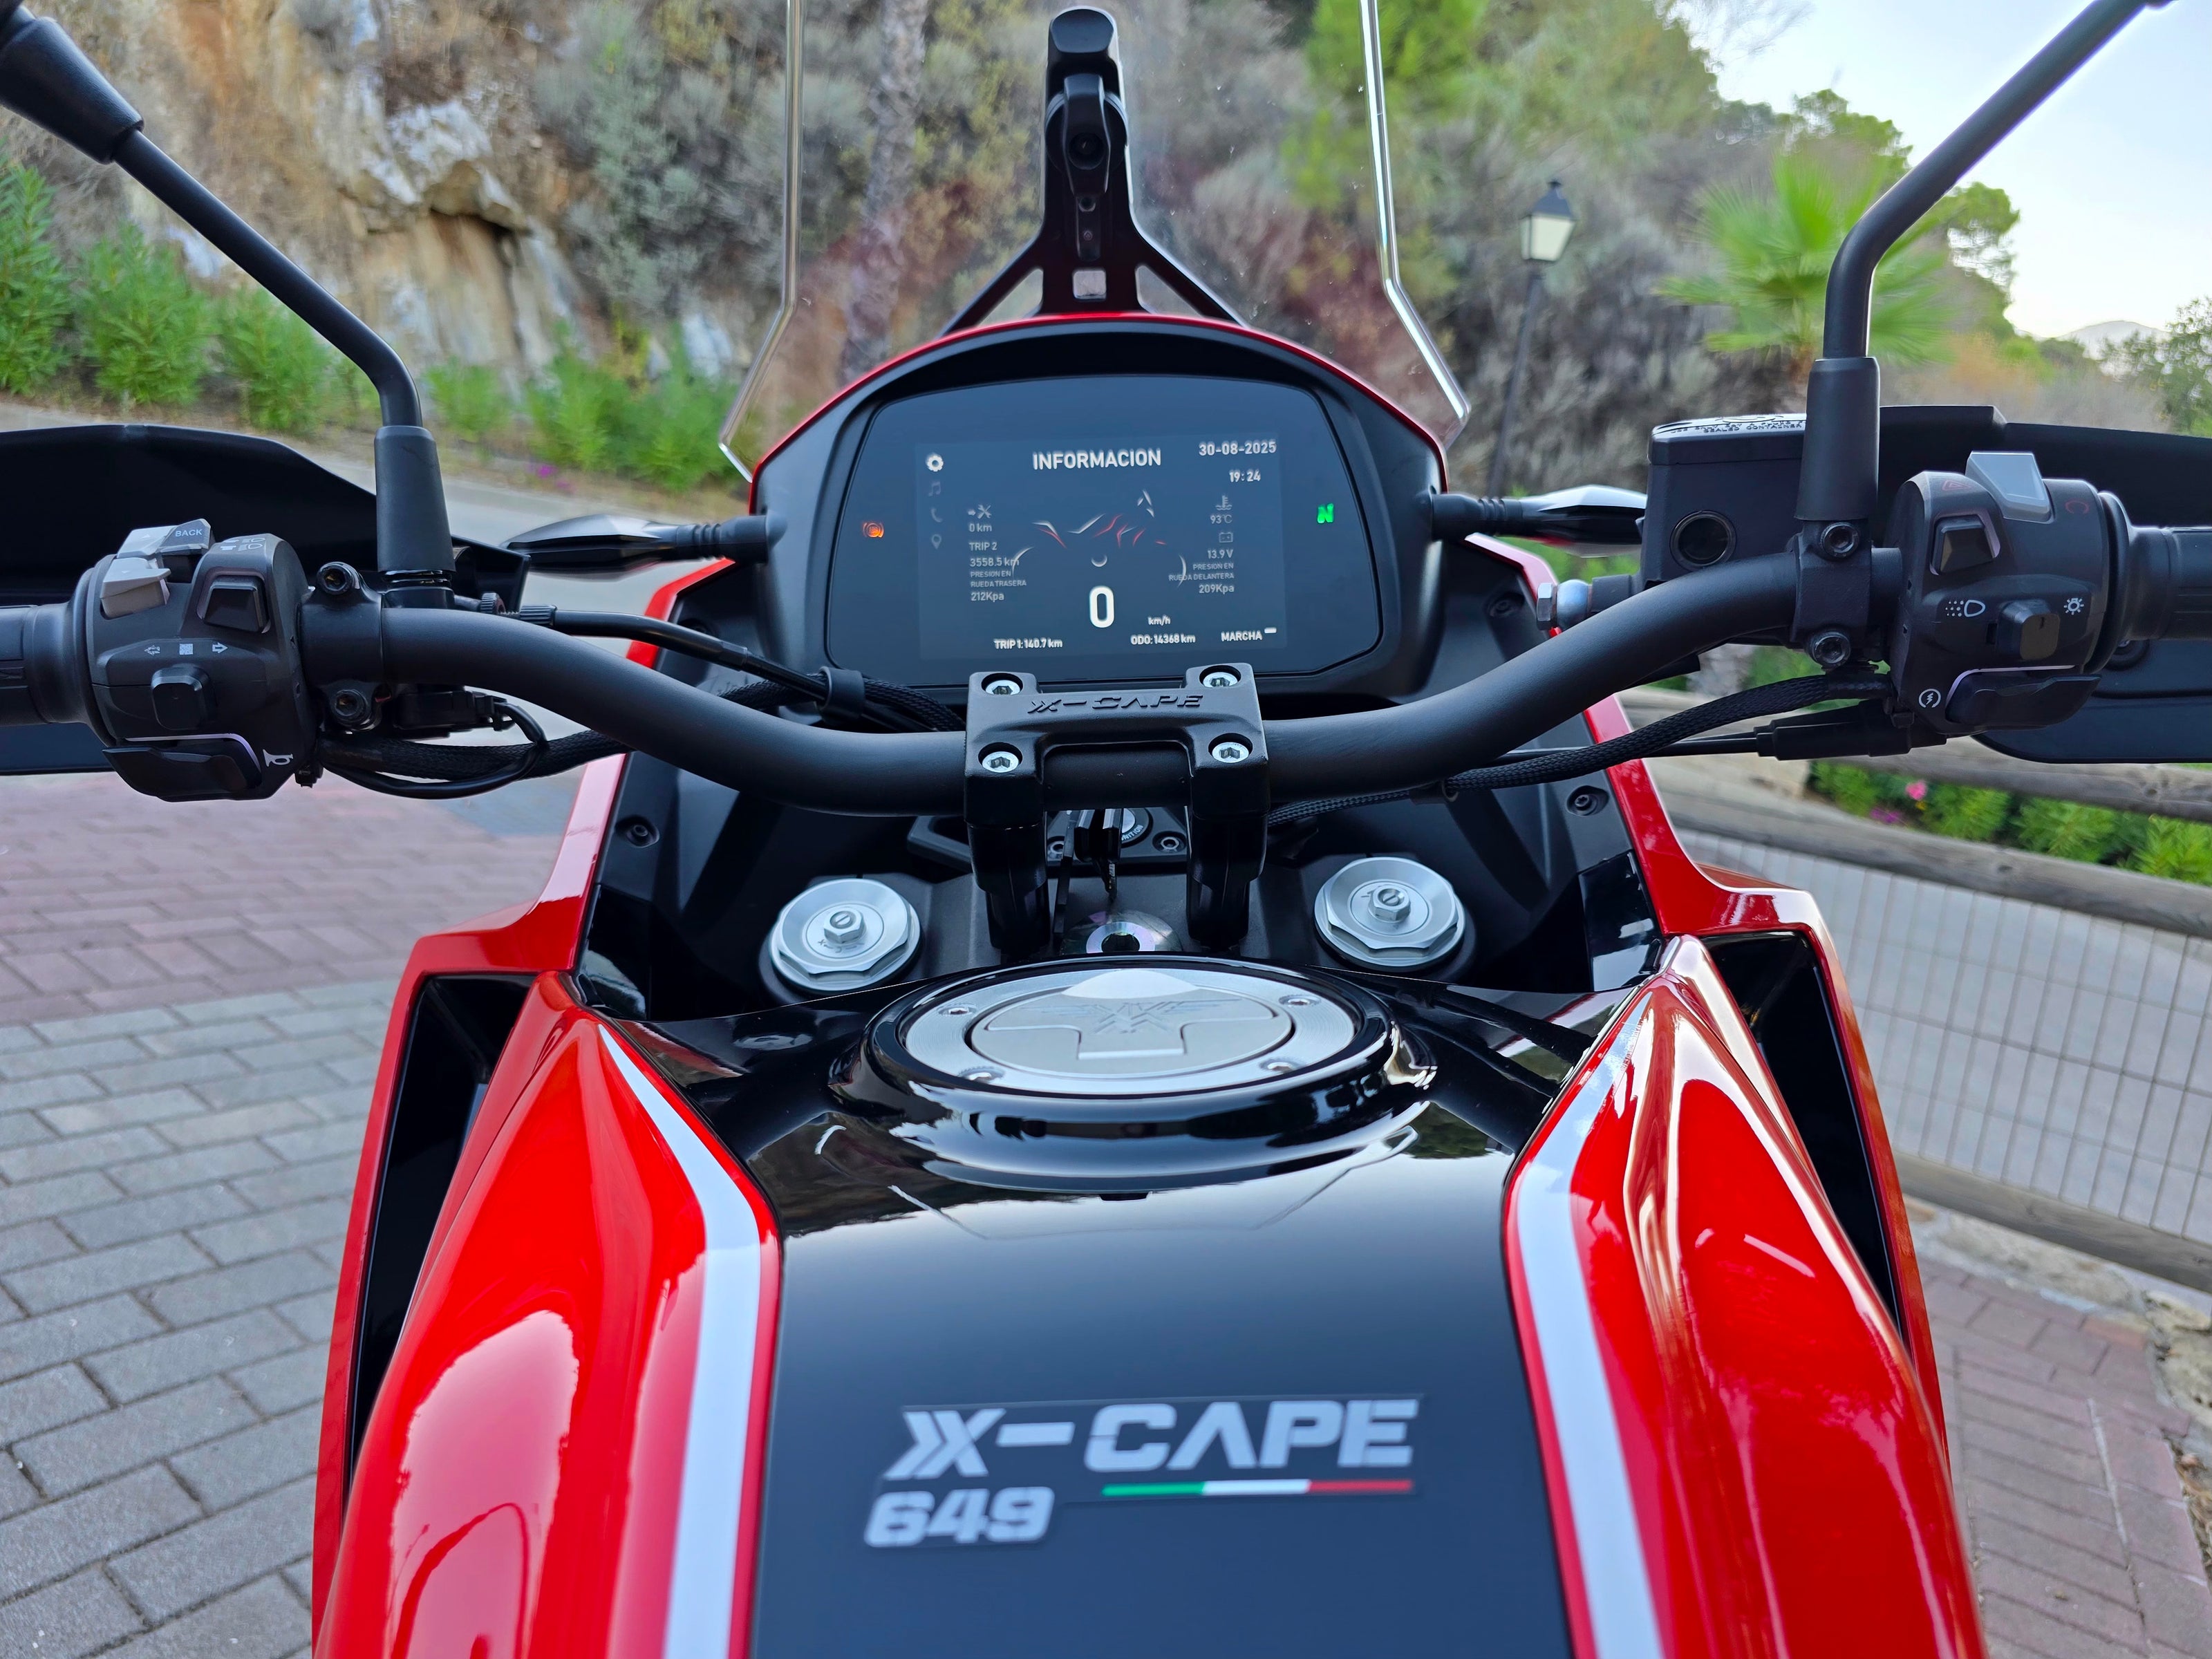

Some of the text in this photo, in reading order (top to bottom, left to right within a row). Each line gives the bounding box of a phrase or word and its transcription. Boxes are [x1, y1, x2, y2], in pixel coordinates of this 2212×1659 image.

[1199, 440, 1277, 456] 30-08-2025
[1033, 449, 1161, 470] INFORMACION
[1317, 503, 1334, 523] N
[175, 529, 203, 537] BACK
[976, 523, 992, 532] km
[968, 541, 997, 551] TRIP 2
[1207, 549, 1234, 559] 13.9 V
[970, 557, 1020, 567] 3558.5 km
[1193, 572, 1235, 581] DELANTERA
[1199, 583, 1235, 594] 209Kpa
[971, 591, 1004, 602] 212Kpa
[1089, 586, 1114, 628] 0
[1147, 615, 1171, 626] km/h
[1130, 632, 1196, 645] ODO: 14368 km
[1221, 630, 1263, 641] MARCHA
[994, 638, 1016, 650] TRIP
[1024, 637, 1047, 648] 140.7
[1047, 637, 1063, 648] km
[1027, 694, 1203, 714] X-CAPE
[1121, 824, 1144, 841] NITION
[883, 1398, 1419, 1481] X-CAPE
[864, 1485, 1055, 1548] 649
